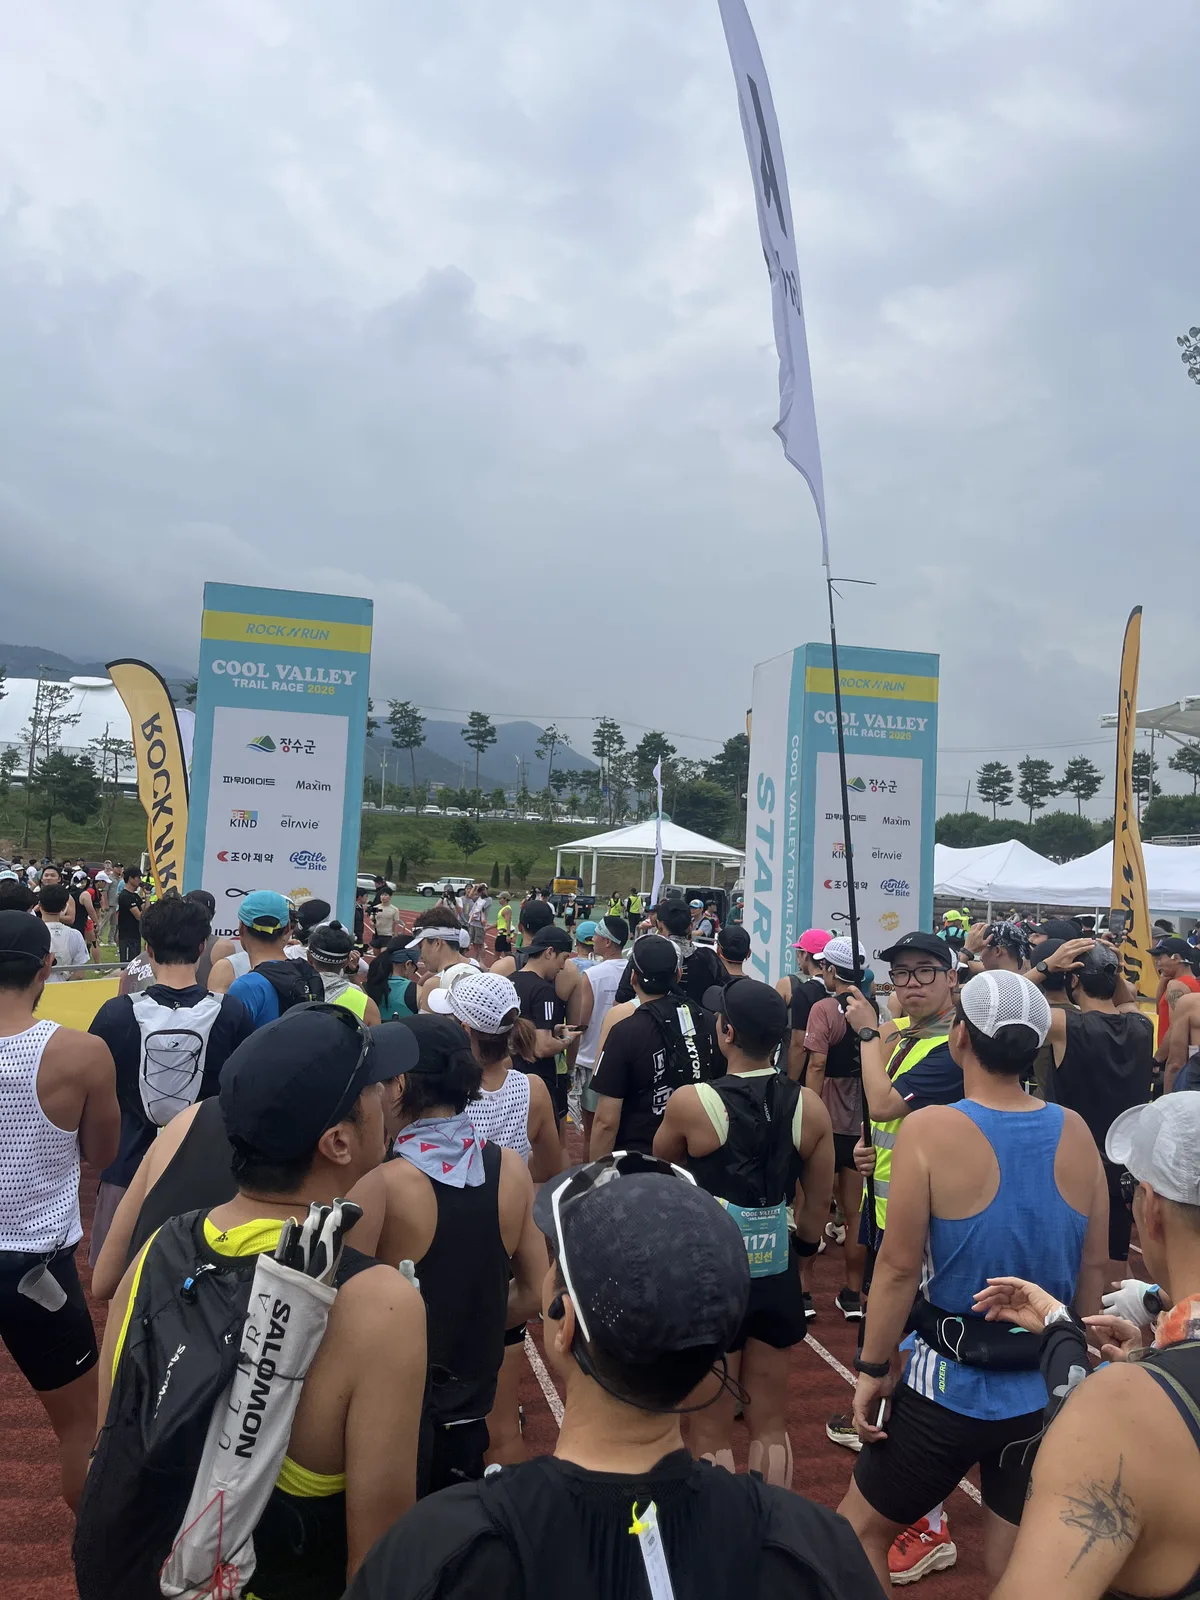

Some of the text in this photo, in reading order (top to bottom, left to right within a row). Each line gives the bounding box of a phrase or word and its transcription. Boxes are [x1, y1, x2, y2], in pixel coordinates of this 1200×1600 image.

[245, 623, 287, 637] ROCK
[301, 628, 330, 641] RUN
[211, 659, 357, 686] COOL VALLEY
[232, 678, 335, 695] TRAIL RACE 2026
[839, 677, 871, 689] ROCK
[883, 680, 906, 692] RUN
[813, 710, 928, 732] COOL VALLEY
[830, 726, 912, 740] TAIL RACE 2026
[279, 738, 316, 755] 장수군
[222, 775, 276, 786] 파워에이드
[295, 780, 331, 792] Maxim
[868, 779, 898, 794] 장수군
[229, 818, 258, 829] KIND
[825, 813, 867, 822] 파워이드
[882, 815, 911, 826] Maxim
[230, 852, 274, 863] 조아제약
[289, 850, 327, 866] Gentle
[784, 735, 799, 974] COOL VALLEY TRAIL RACE
[308, 863, 327, 871] Bite
[752, 772, 776, 985] START
[880, 878, 910, 893] Gentle
[895, 889, 910, 897] Bite
[742, 1233, 777, 1250] 1171
[234, 1298, 292, 1459] SALOMON
[938, 1360, 947, 1394] ADIZERO
